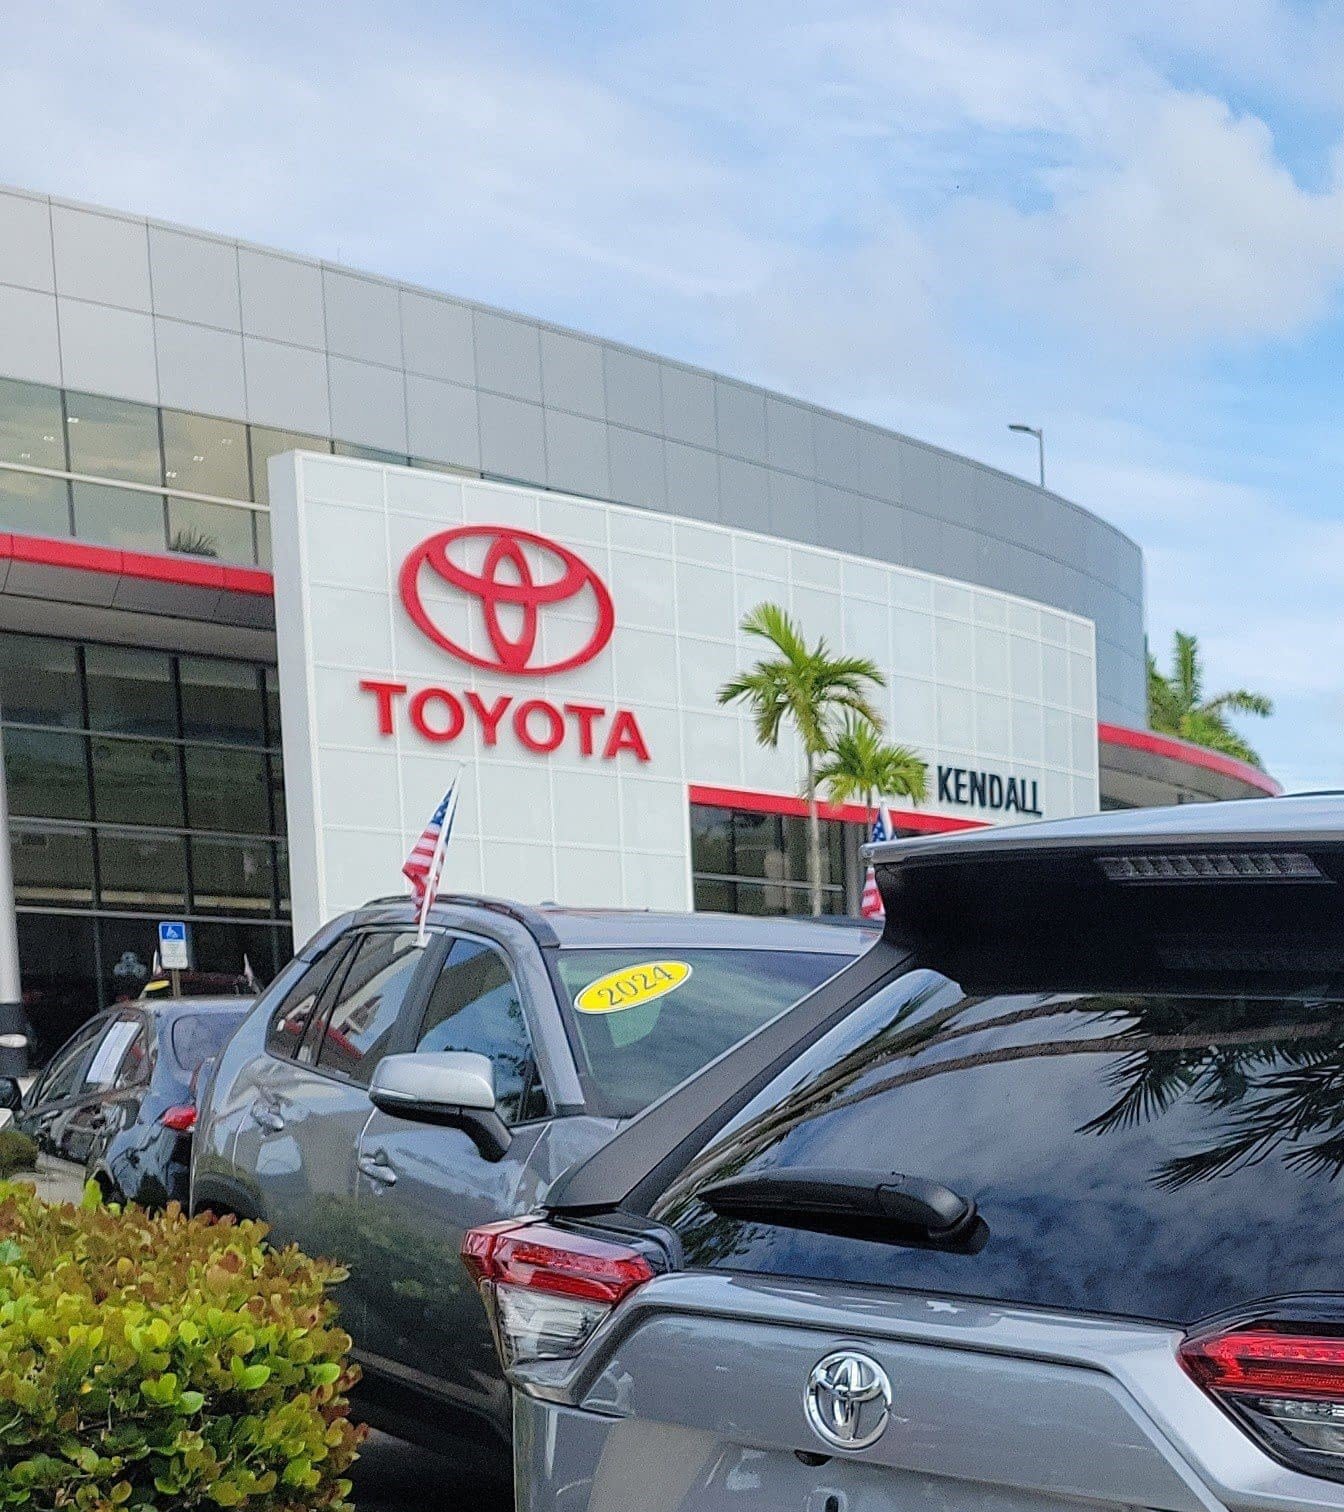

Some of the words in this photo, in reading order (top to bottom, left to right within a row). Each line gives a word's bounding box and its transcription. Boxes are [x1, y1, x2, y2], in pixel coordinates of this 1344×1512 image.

[359, 680, 652, 763] TOYOTA
[937, 765, 1042, 818] KENDALL
[597, 966, 674, 1006] 2024
